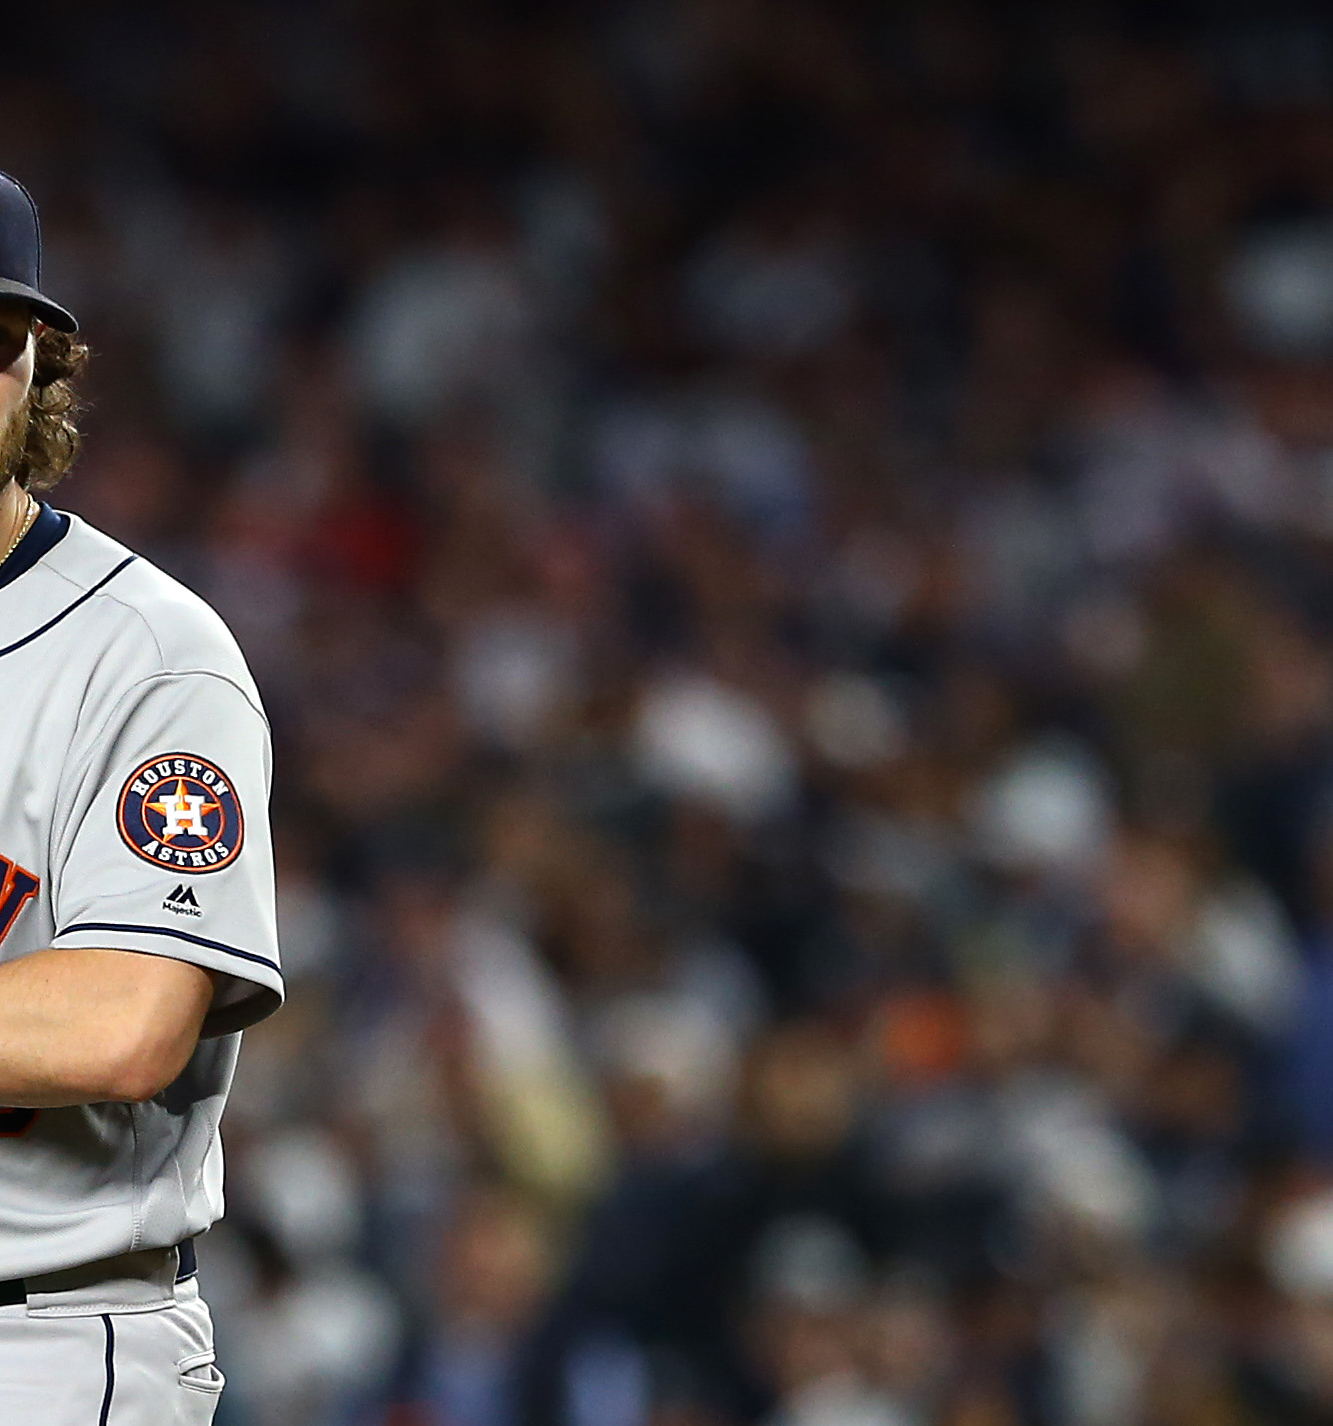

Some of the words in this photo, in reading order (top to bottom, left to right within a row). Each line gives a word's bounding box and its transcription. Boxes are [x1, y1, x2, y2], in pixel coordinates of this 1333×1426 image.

[131, 760, 228, 796] HOUSTON
[159, 795, 208, 836] H
[142, 841, 229, 867] ASTROS
[162, 902, 202, 918] Majestic
